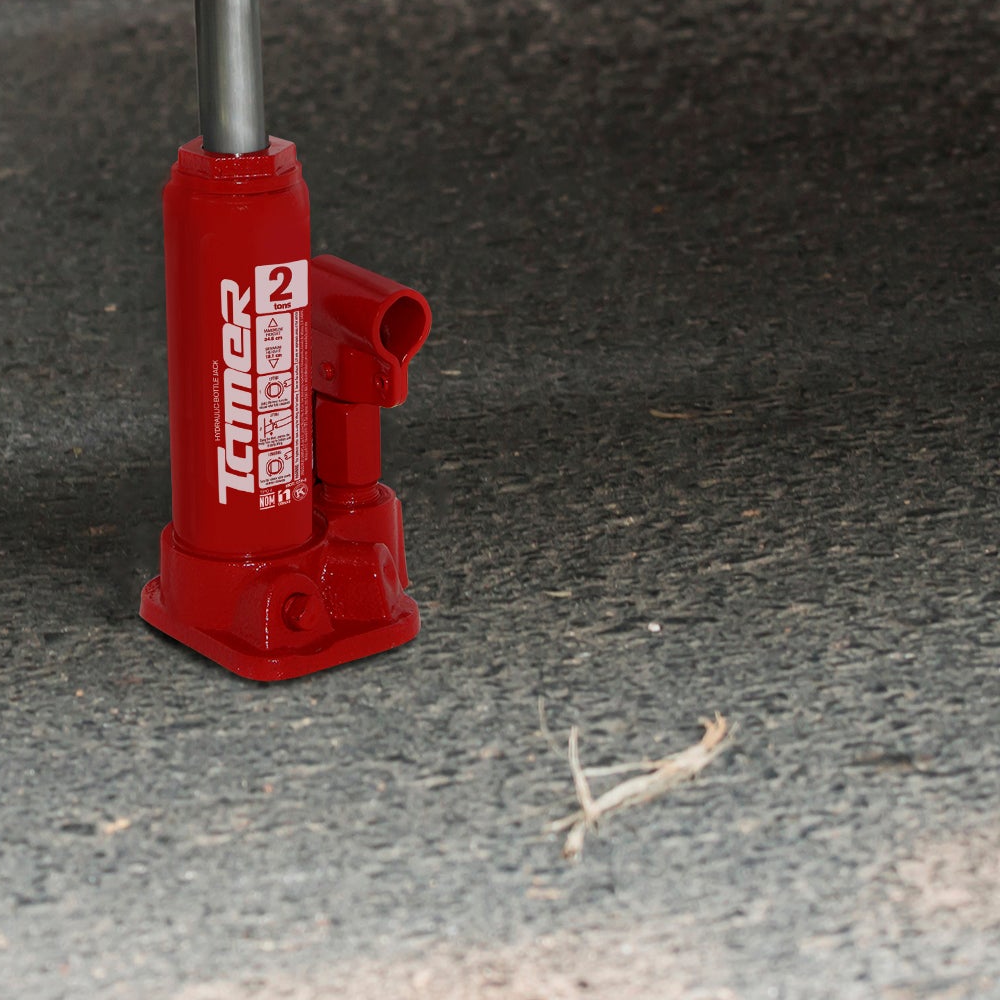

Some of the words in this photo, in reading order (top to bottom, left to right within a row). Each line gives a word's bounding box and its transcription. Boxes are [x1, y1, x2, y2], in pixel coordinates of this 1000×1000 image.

[269, 266, 293, 302] 2
[274, 302, 292, 310] tons
[213, 403, 221, 441] HYDRAULIC
[259, 494, 276, 508] NOM
